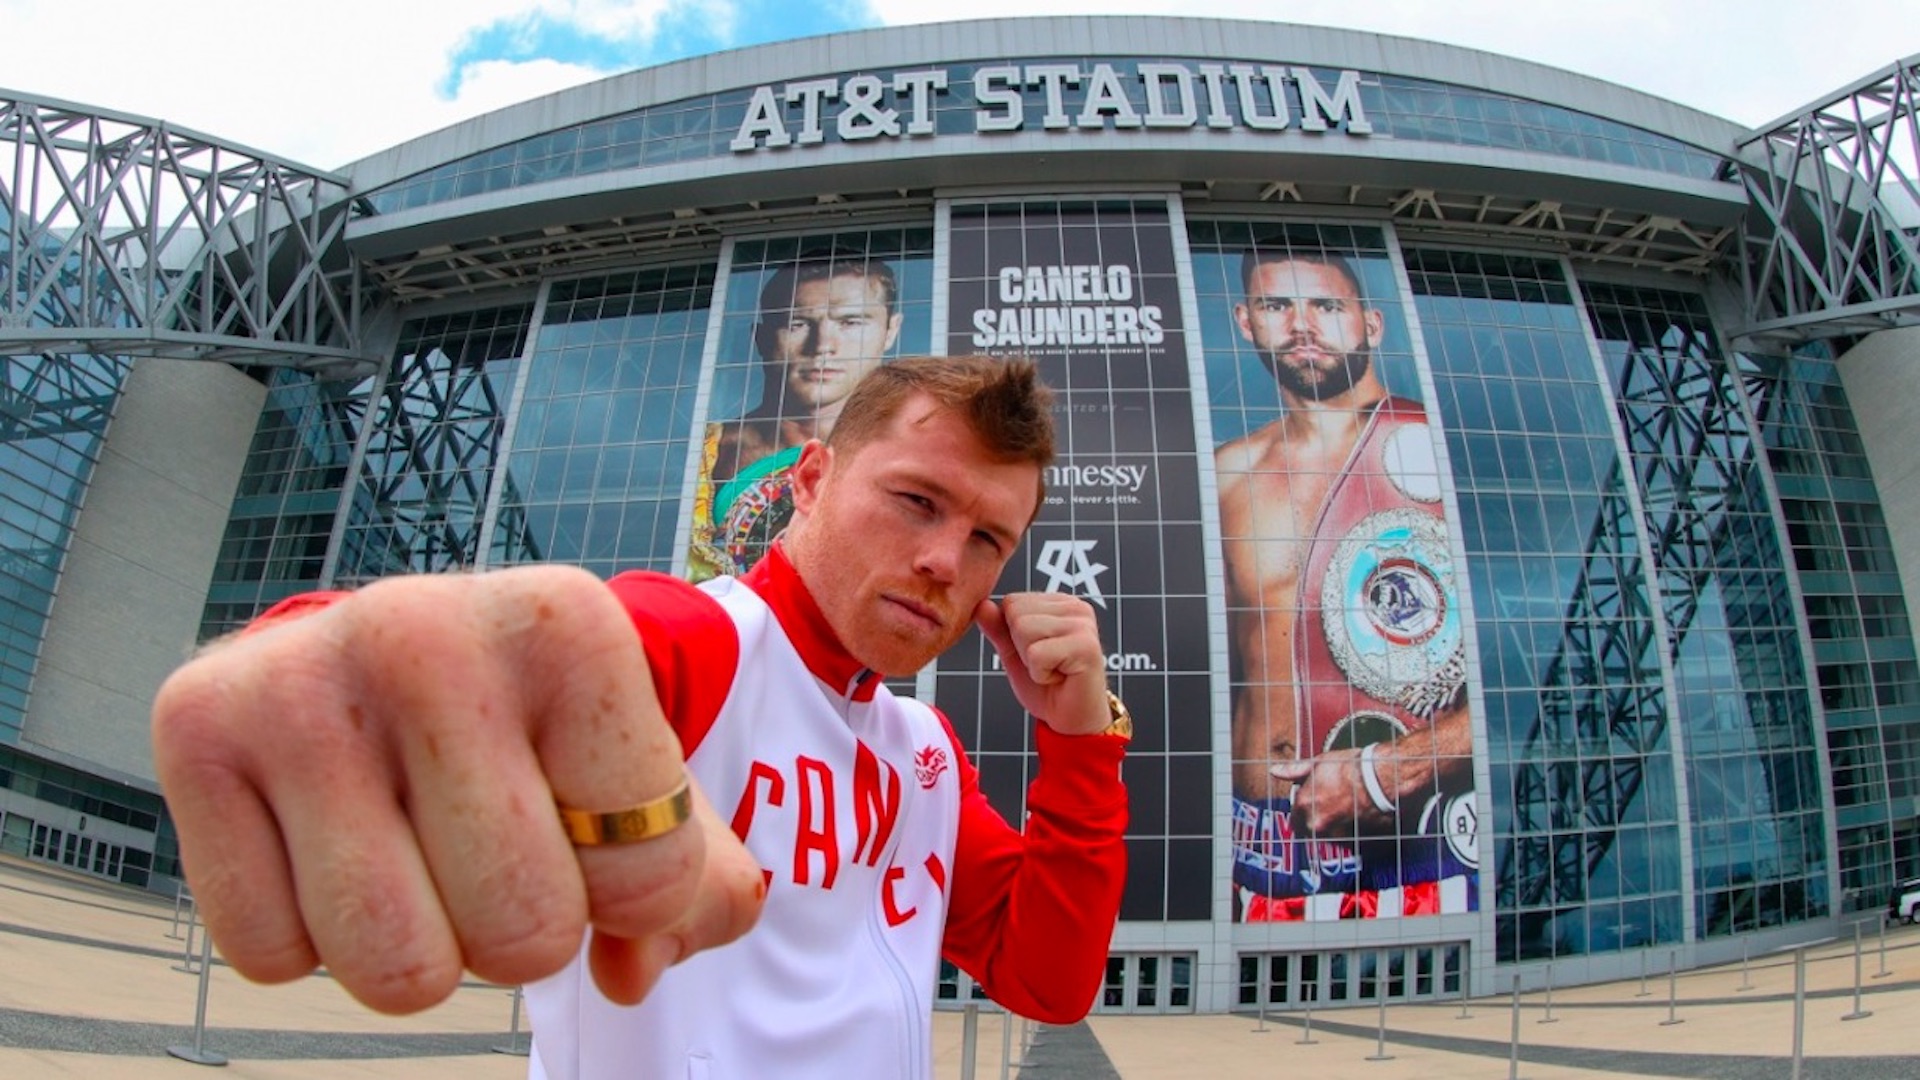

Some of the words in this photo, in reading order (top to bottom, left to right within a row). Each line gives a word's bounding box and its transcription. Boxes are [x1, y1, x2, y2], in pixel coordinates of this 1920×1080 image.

[730, 71, 948, 151] AT&T
[974, 62, 1372, 135] STADIUM
[999, 264, 1133, 303] CANELO
[973, 305, 1163, 348] SAUNDERS
[1043, 464, 1148, 492] nnessy
